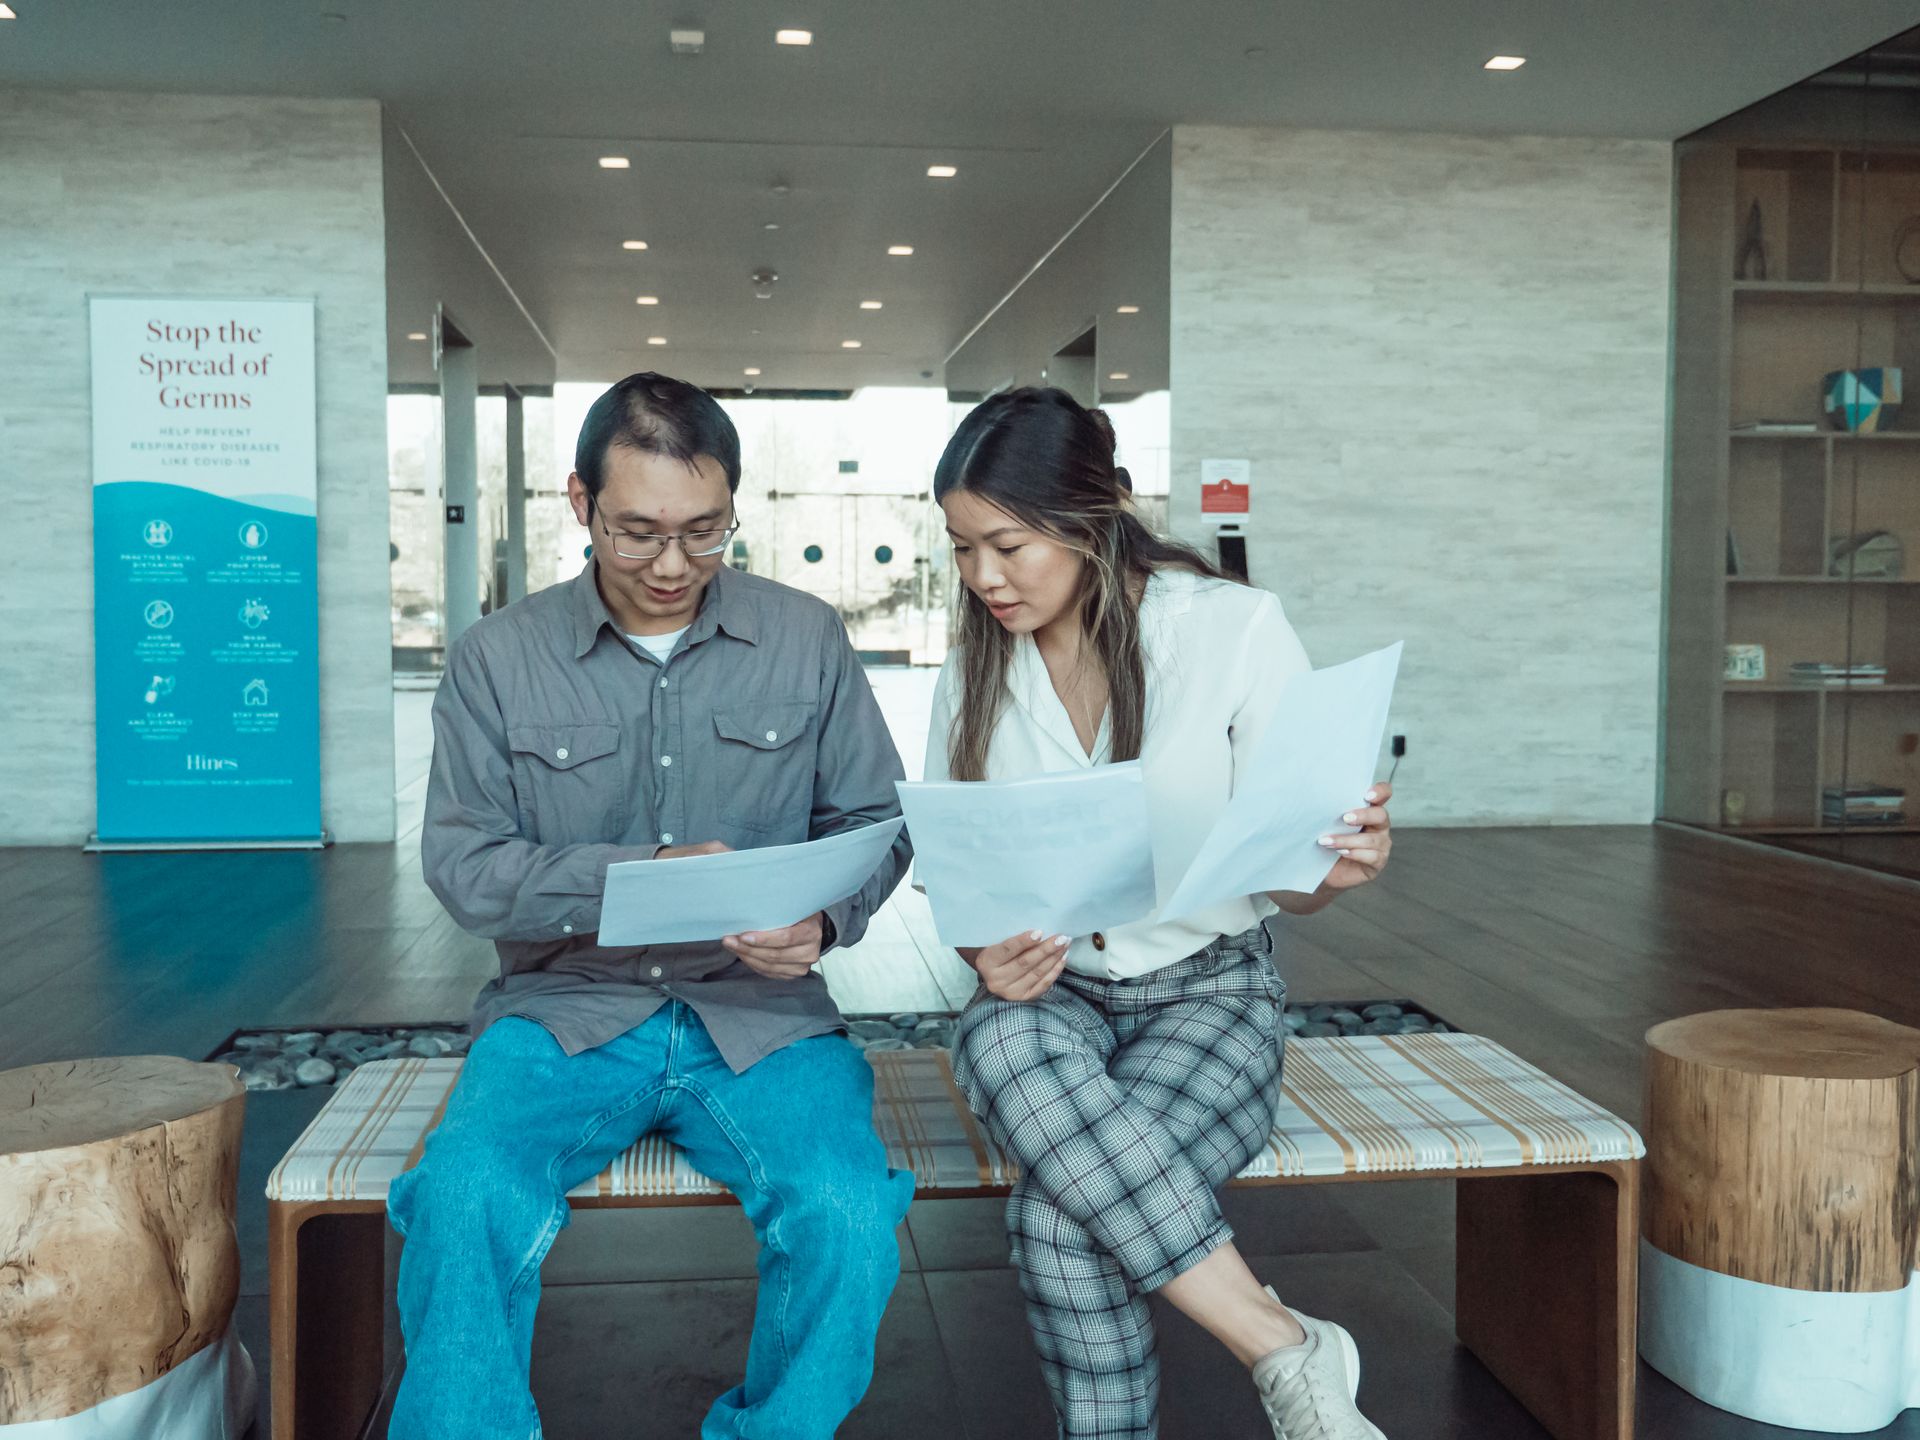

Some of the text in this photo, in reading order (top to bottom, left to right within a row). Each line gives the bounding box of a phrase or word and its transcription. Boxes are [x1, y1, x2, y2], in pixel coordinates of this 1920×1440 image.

[146, 318, 262, 351] Stop the
[139, 352, 273, 383] Spread of
[159, 385, 252, 410] Germs
[159, 427, 252, 437] HELP PREVENT
[130, 442, 281, 452] RESPIRATORY DISEASES
[160, 457, 251, 466] LIKE COVID-19
[186, 753, 239, 771] Hines
